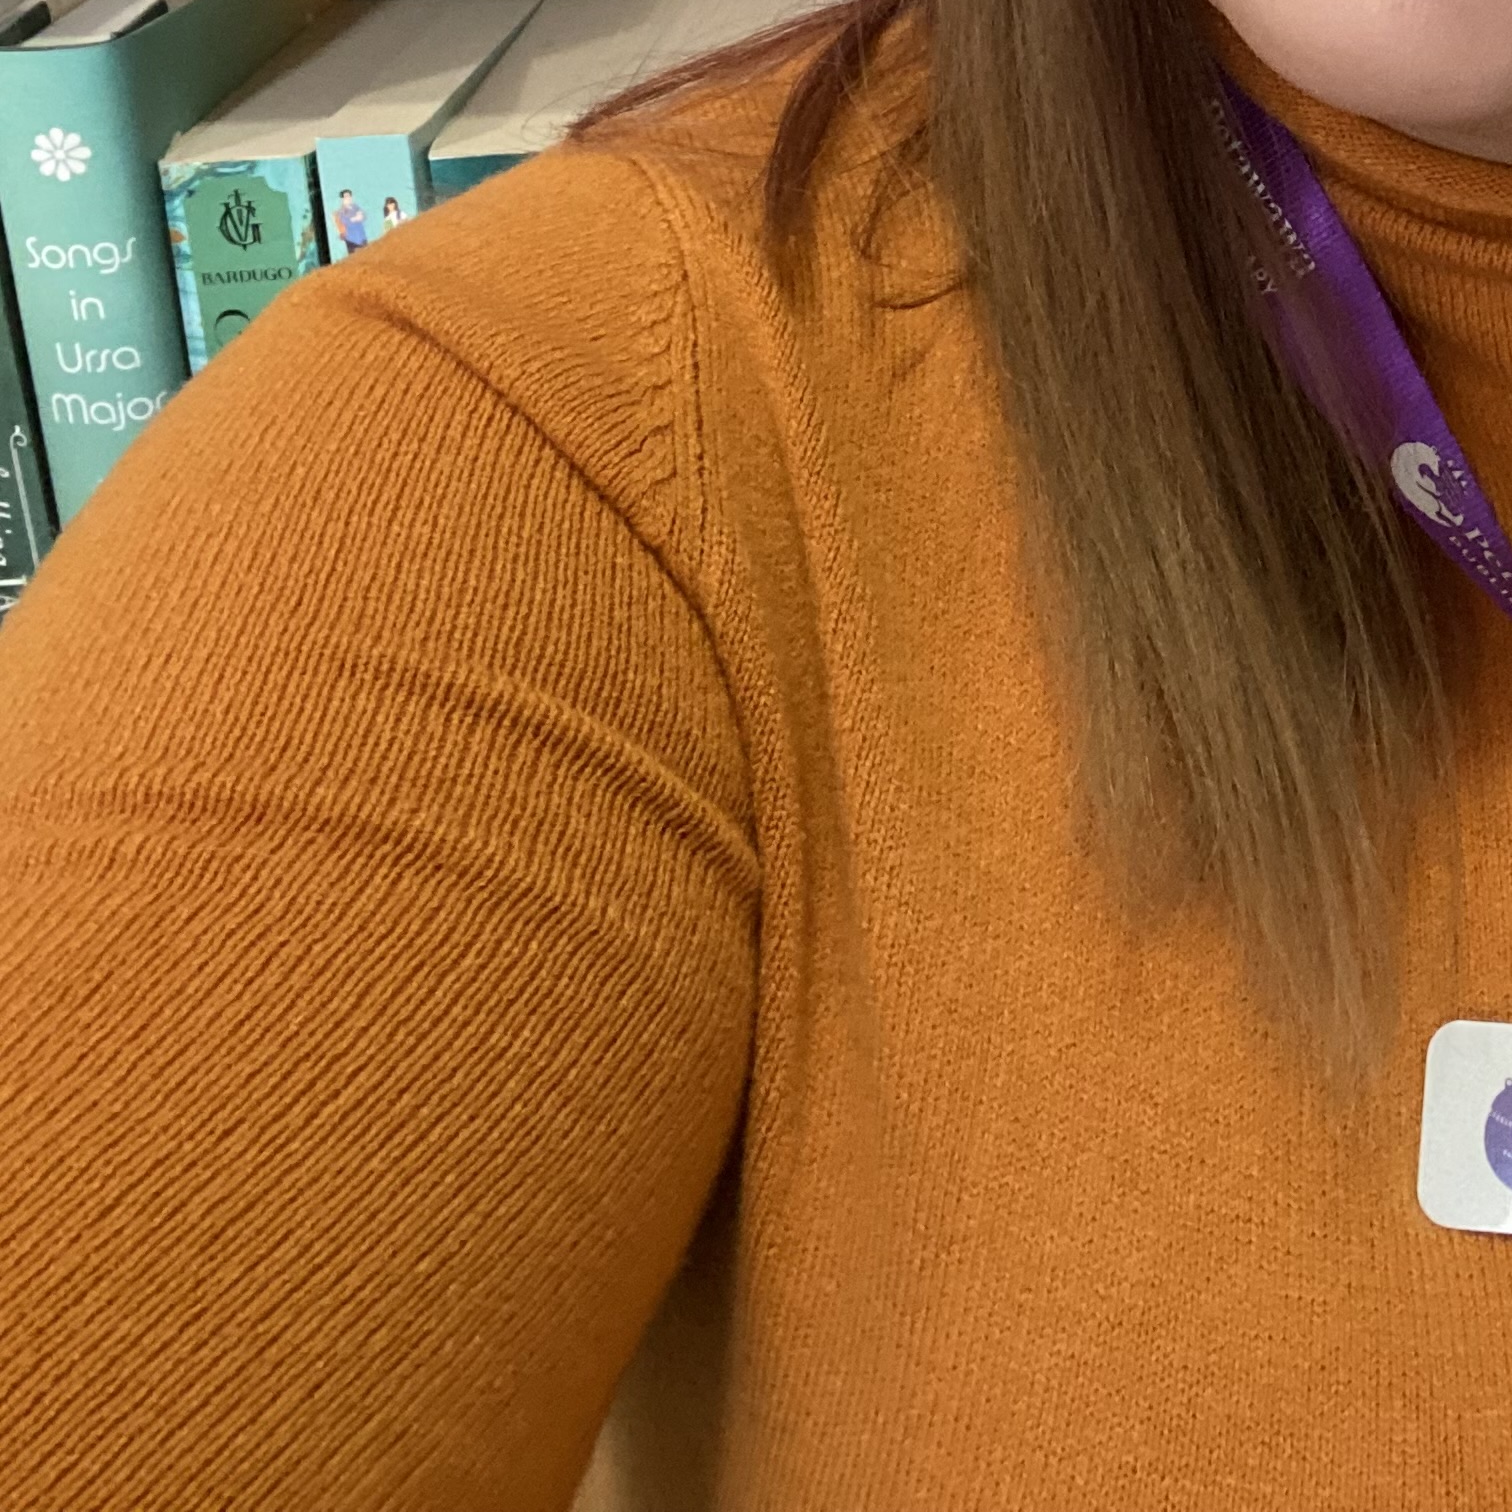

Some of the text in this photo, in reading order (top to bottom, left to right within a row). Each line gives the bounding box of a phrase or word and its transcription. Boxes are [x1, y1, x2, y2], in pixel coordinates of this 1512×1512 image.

[25, 236, 137, 275] Songs
[201, 266, 293, 287] BARDUGO
[68, 289, 106, 322] in
[55, 341, 142, 374] Ursa
[51, 390, 168, 432] Major
